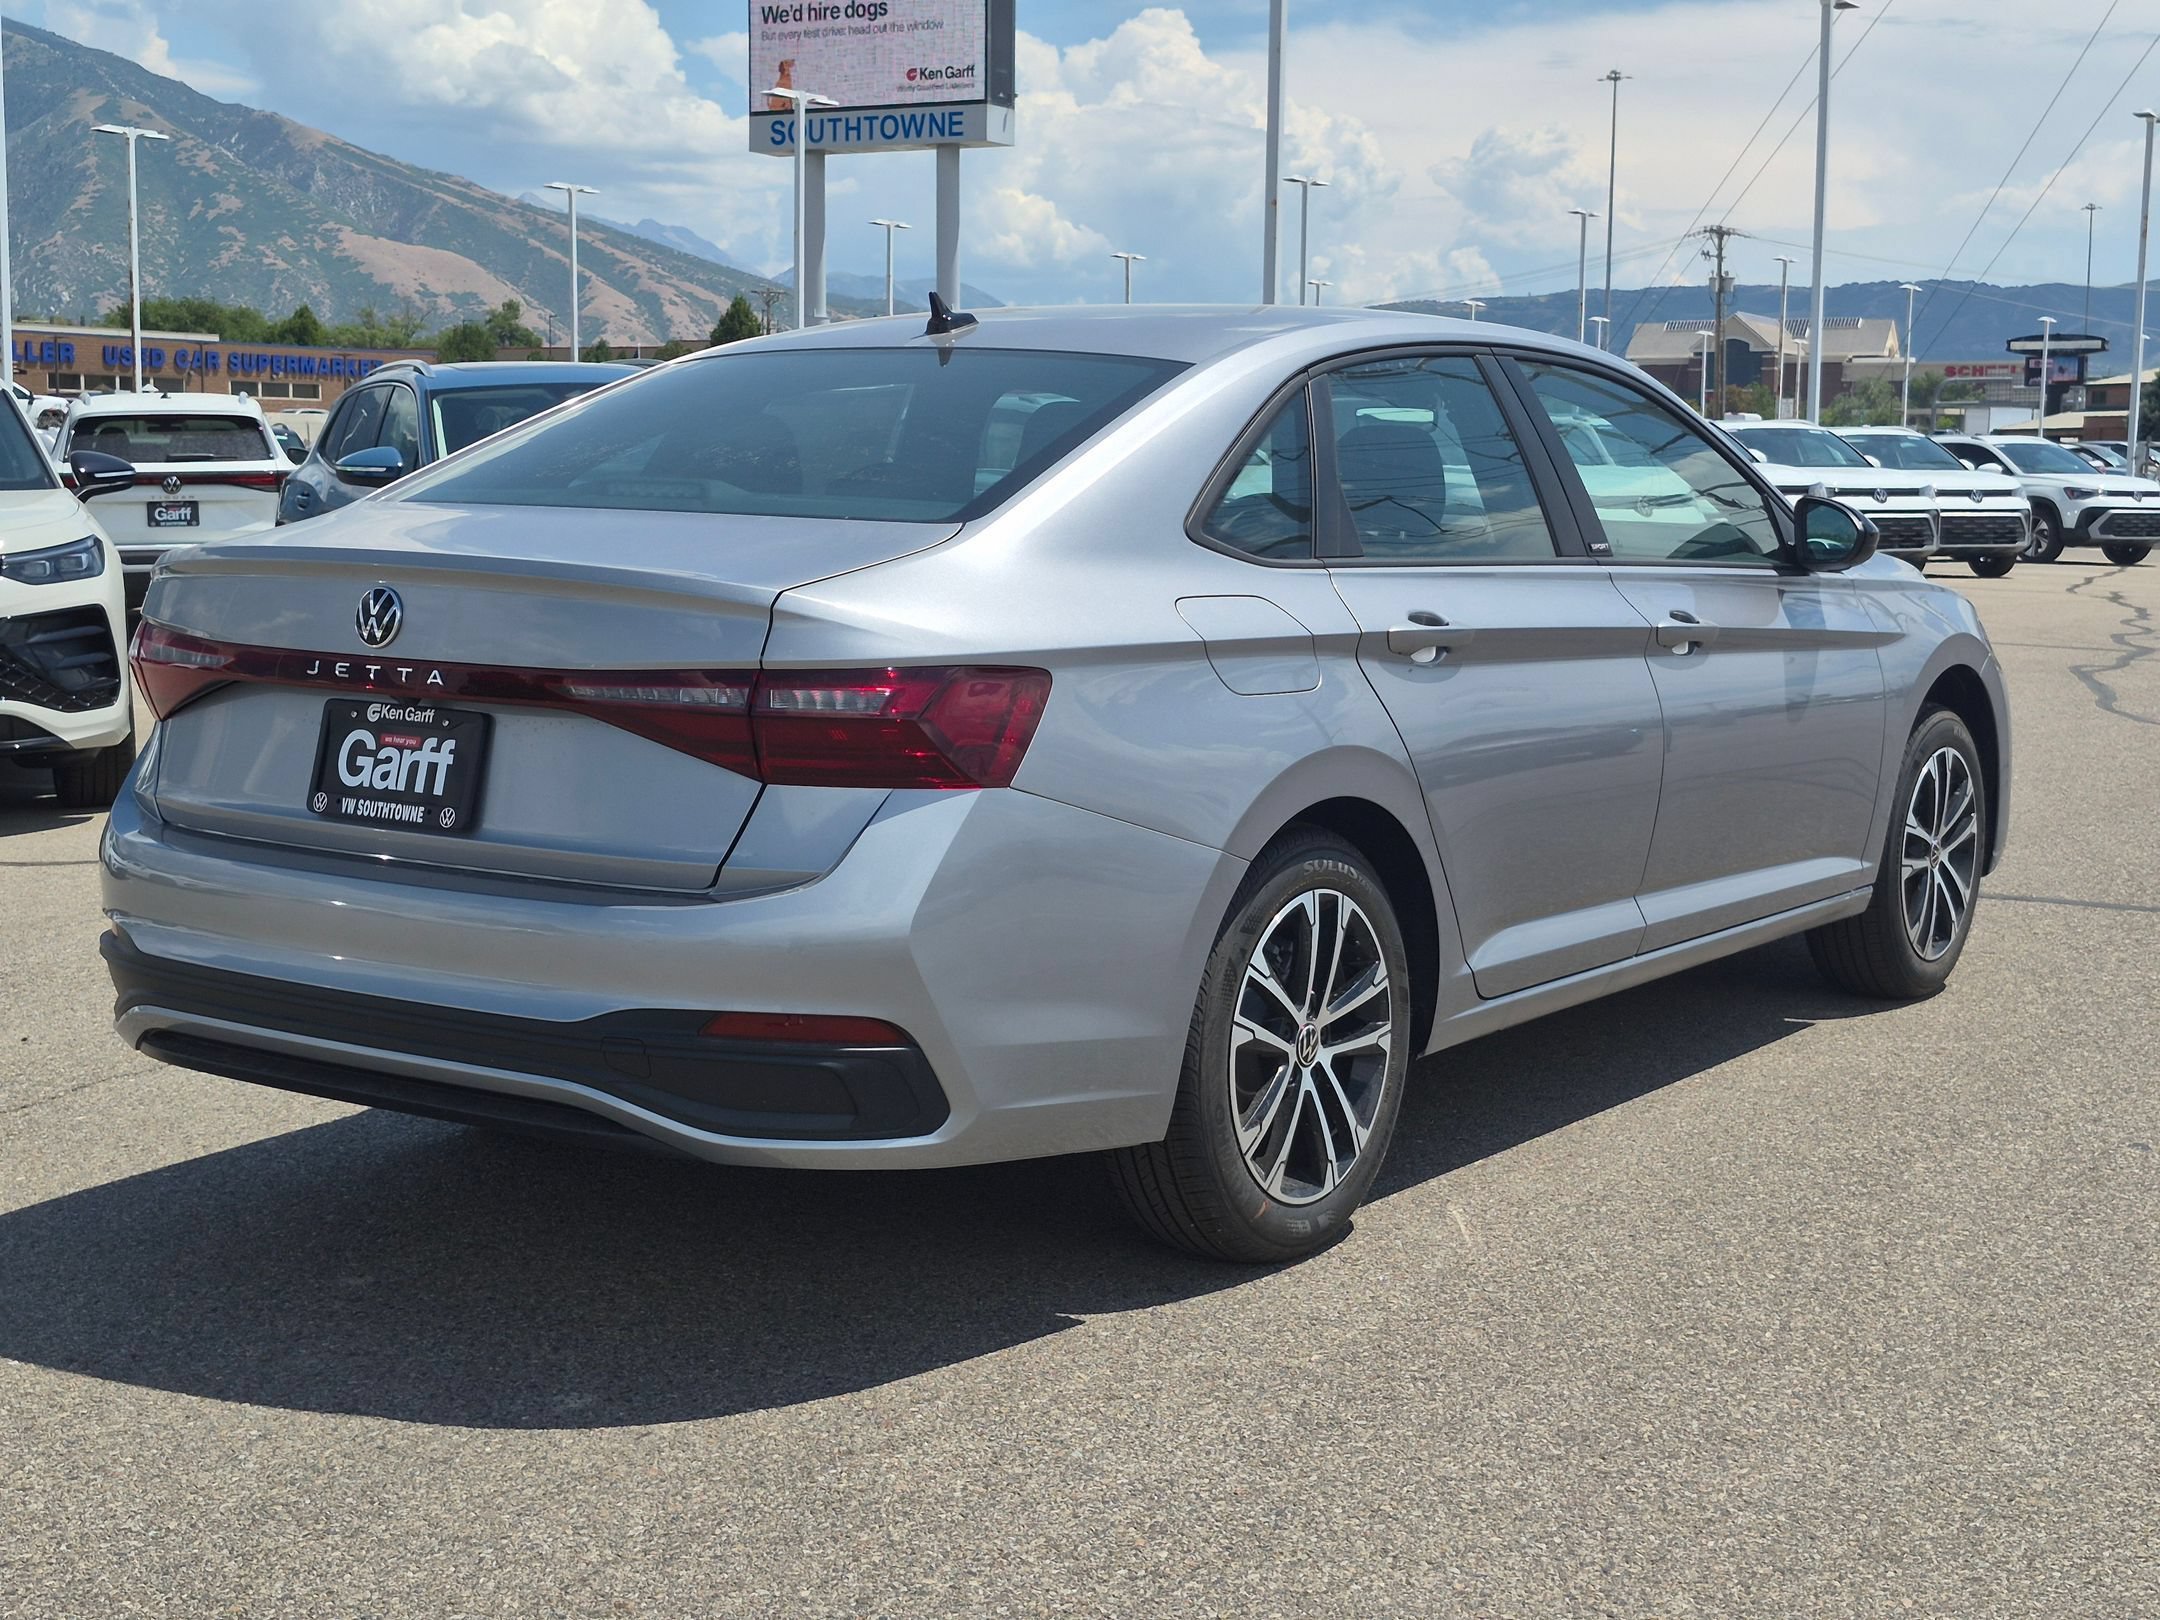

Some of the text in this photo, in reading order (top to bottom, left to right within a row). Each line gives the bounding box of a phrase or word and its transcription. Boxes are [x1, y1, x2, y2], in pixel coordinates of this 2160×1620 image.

[761, 0, 888, 25] We'd hire dogs
[920, 65, 975, 80] Ken Garff
[103, 345, 165, 367] USED
[175, 349, 220, 369] CAR
[154, 507, 192, 521] Garff
[306, 660, 444, 686] JETTA
[381, 703, 436, 723] Ken Garff
[405, 738, 417, 746] you
[337, 728, 456, 796] Garff
[341, 797, 425, 823] VW SOUTHTOWNE
[1303, 859, 1358, 879] SOLUS
